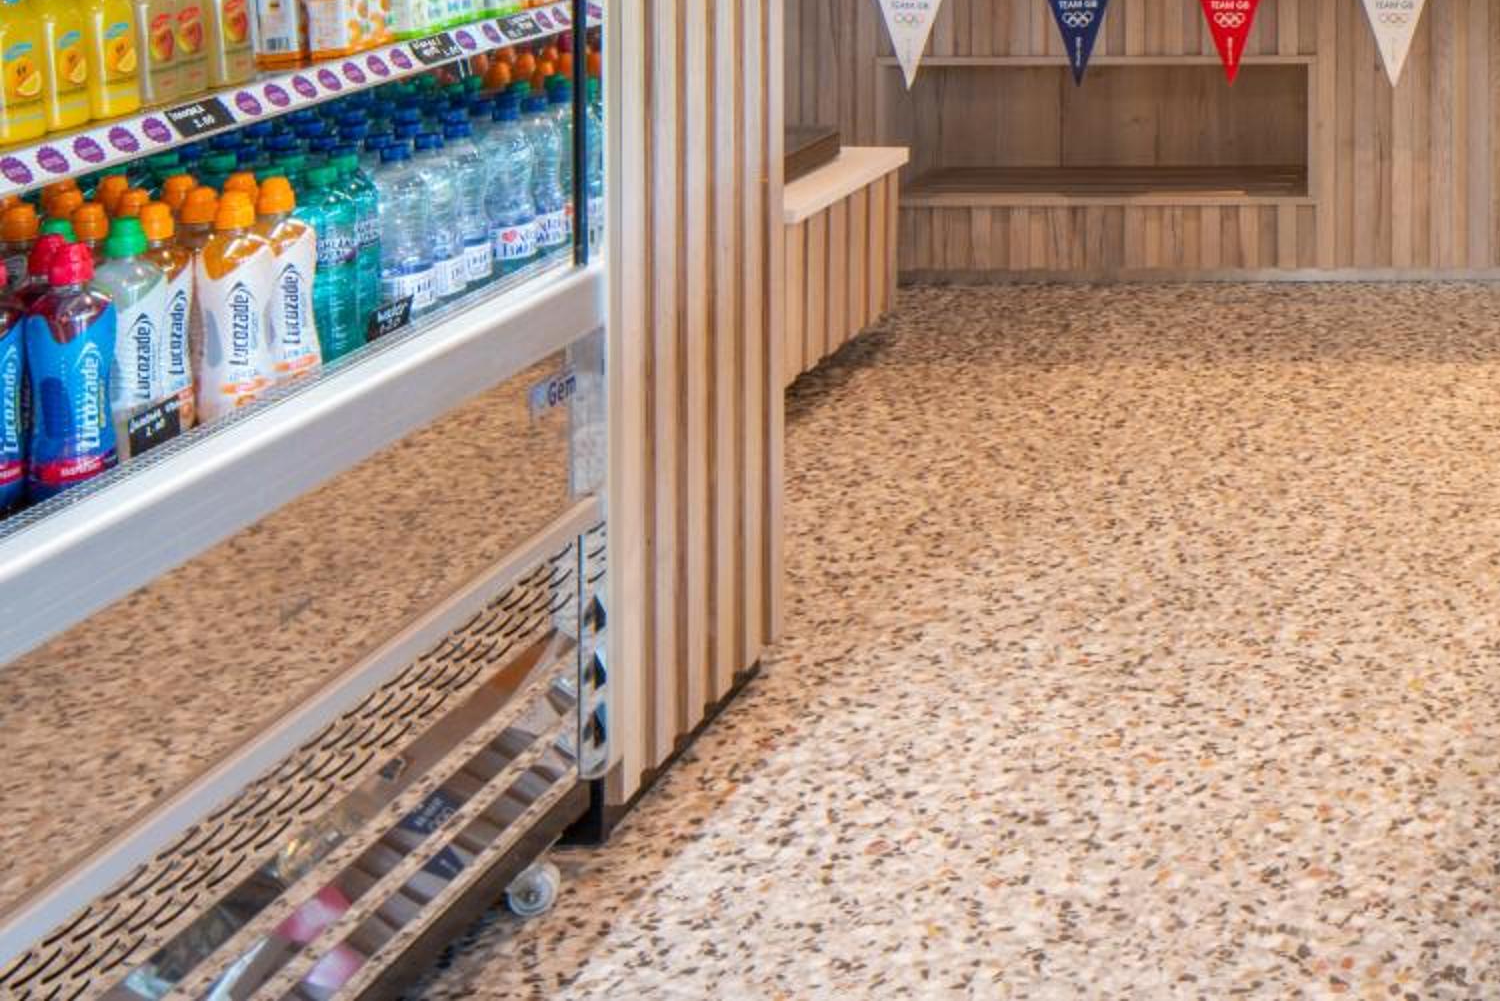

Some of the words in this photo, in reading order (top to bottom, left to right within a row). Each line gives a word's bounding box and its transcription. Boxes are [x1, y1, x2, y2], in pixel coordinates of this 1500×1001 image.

[1059, 0, 1083, 9] TEAM
[1085, 0, 1097, 9] GB
[1211, 0, 1234, 10] TEAM
[1236, 0, 1249, 10] GB
[1375, 0, 1399, 10] TEAM
[1401, 0, 1413, 10] GB
[168, 301, 186, 376] Lucozade
[228, 294, 249, 366] Lucozade
[281, 276, 299, 345] Lucozade
[133, 324, 151, 399] Lucozade
[3, 361, 18, 454] Lucozade
[80, 356, 100, 449] Lucozade
